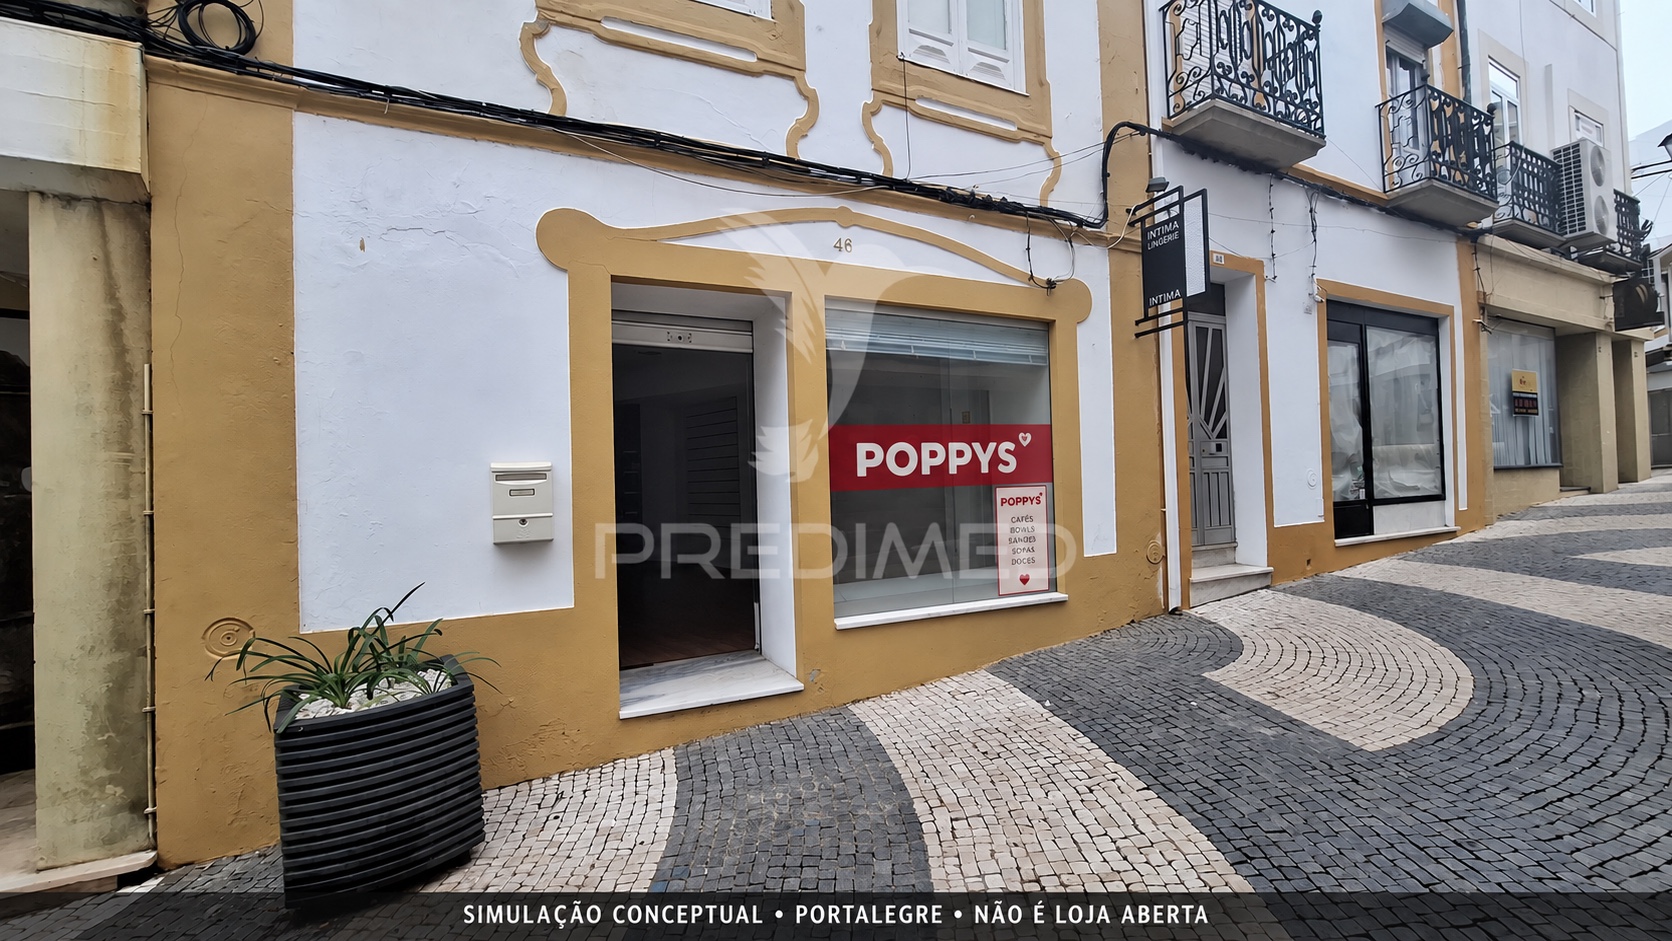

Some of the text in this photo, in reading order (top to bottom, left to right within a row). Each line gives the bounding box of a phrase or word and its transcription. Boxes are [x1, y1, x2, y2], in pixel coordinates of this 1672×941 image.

[1147, 221, 1180, 240] INTIMA
[833, 237, 853, 253] 46
[1147, 231, 1180, 250] LINGERIE
[1149, 289, 1181, 306] INTIMA
[856, 441, 1018, 477] POPPYS
[1000, 495, 1042, 507] POPPYS
